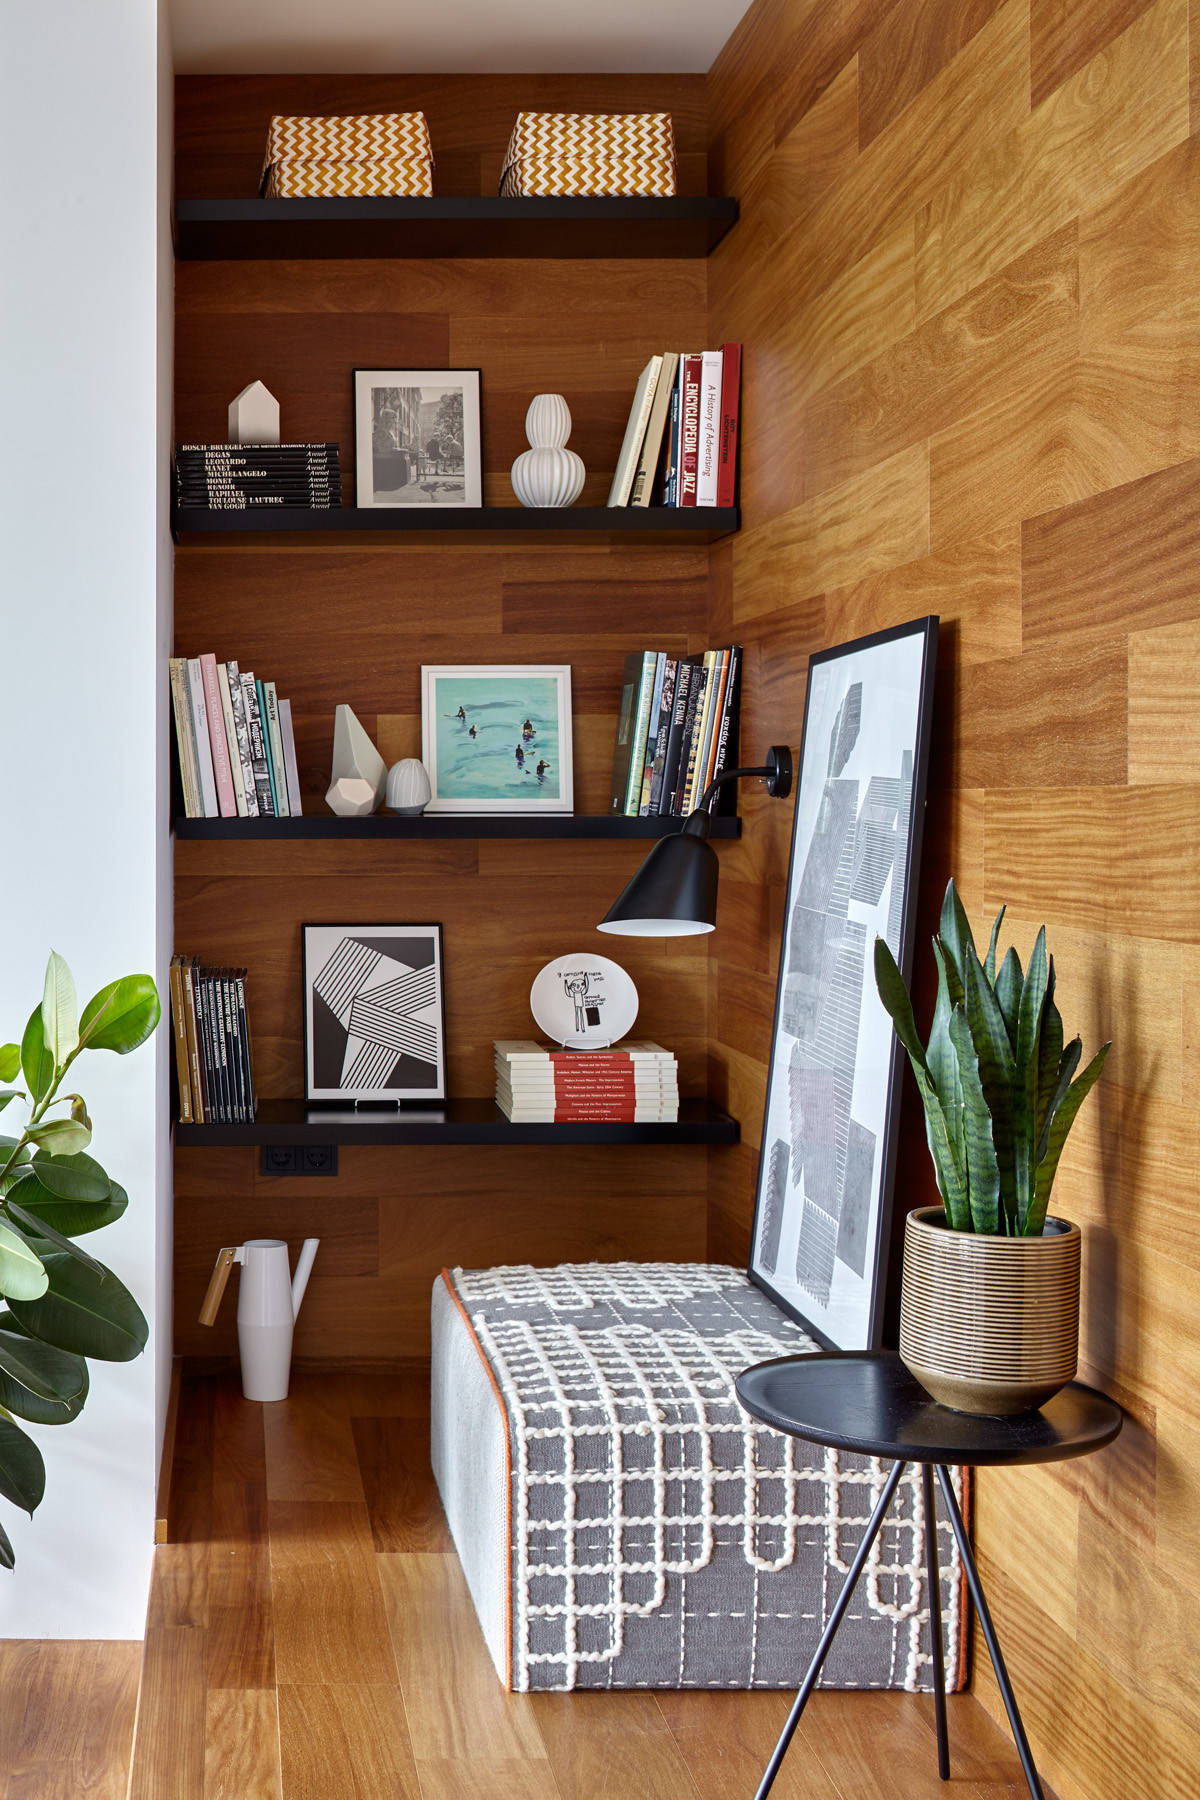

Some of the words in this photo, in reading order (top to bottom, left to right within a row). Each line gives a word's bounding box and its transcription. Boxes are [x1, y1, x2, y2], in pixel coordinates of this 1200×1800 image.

[685, 384, 698, 453] ENCYCLOPEDIA
[705, 394, 716, 421] History
[705, 423, 714, 432] of
[684, 456, 696, 468] OF
[702, 433, 714, 477] Advertising
[683, 470, 696, 493] JAZZ
[678, 664, 691, 697] MICHAEL
[689, 673, 700, 698] BRIAN
[674, 700, 686, 725] KENNA
[251, 723, 263, 759] МОДЕРНИЗМ
[720, 716, 730, 746] Уорхол
[716, 746, 726, 770] Энди
